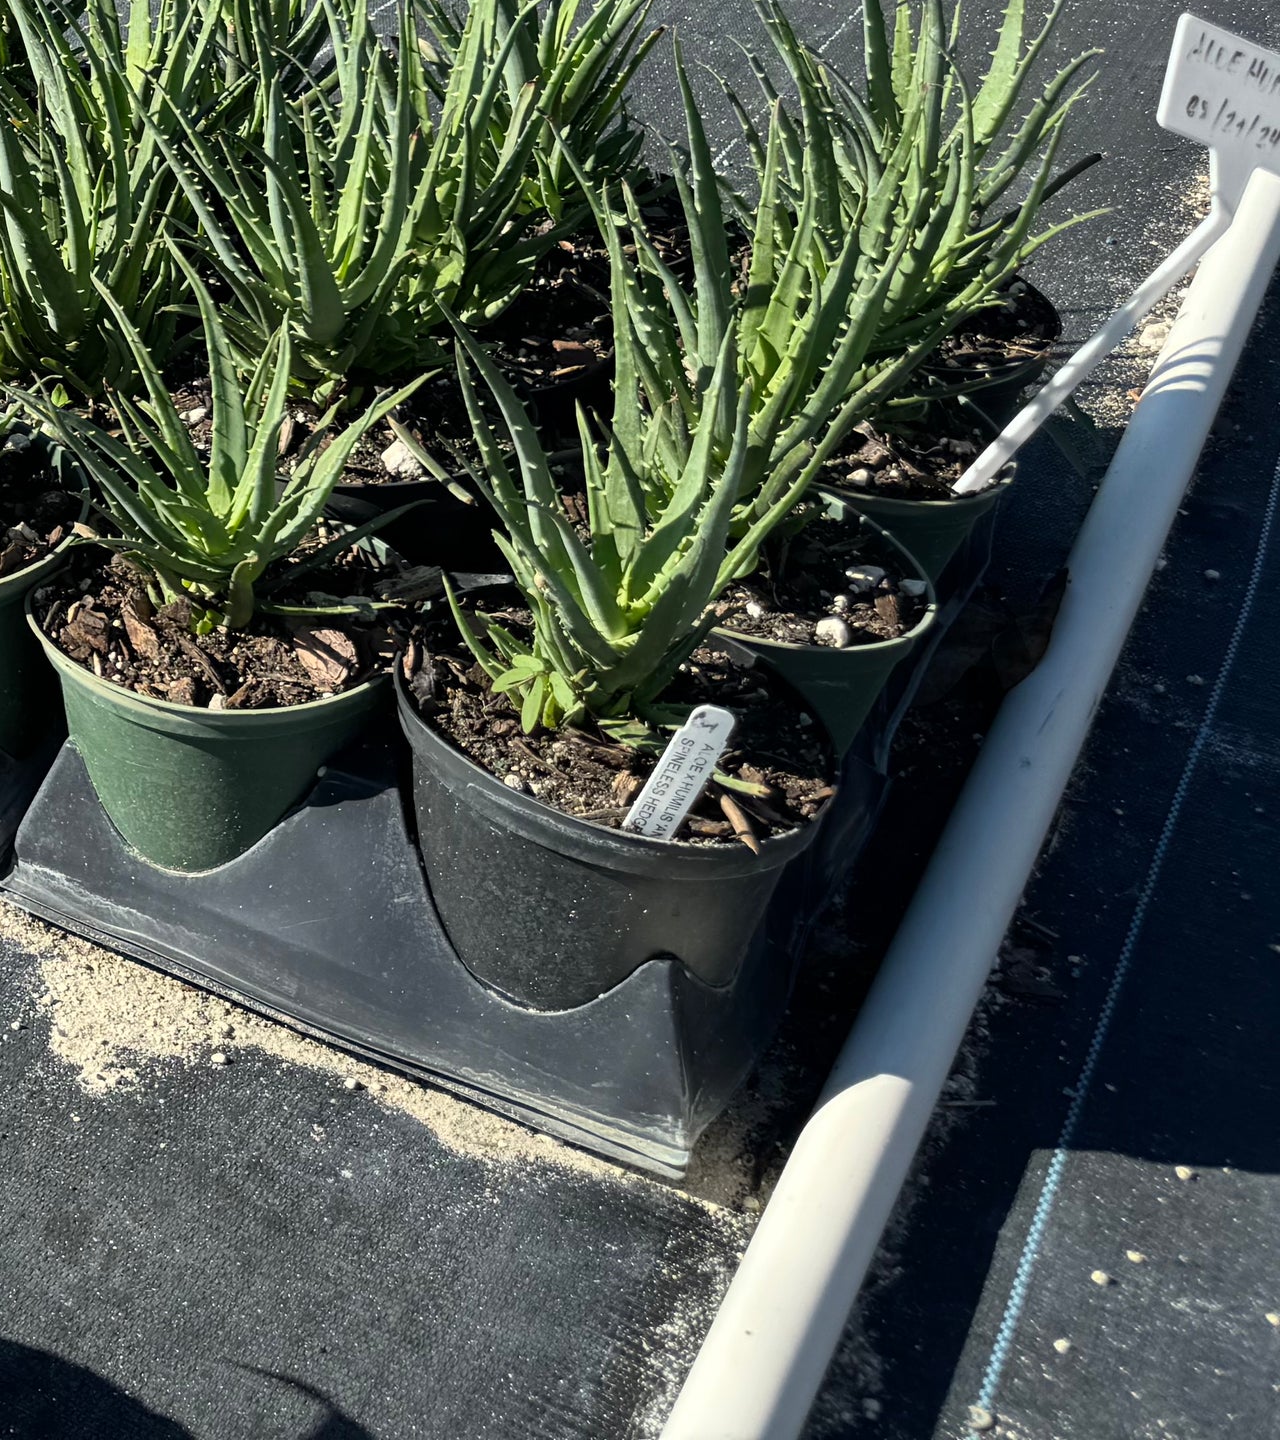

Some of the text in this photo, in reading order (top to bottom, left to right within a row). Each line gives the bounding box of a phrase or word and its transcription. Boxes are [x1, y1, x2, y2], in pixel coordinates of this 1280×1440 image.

[651, 737, 695, 797] SPINELESS
[689, 743, 715, 774] ALOE
[659, 781, 694, 822] HUMILIS
